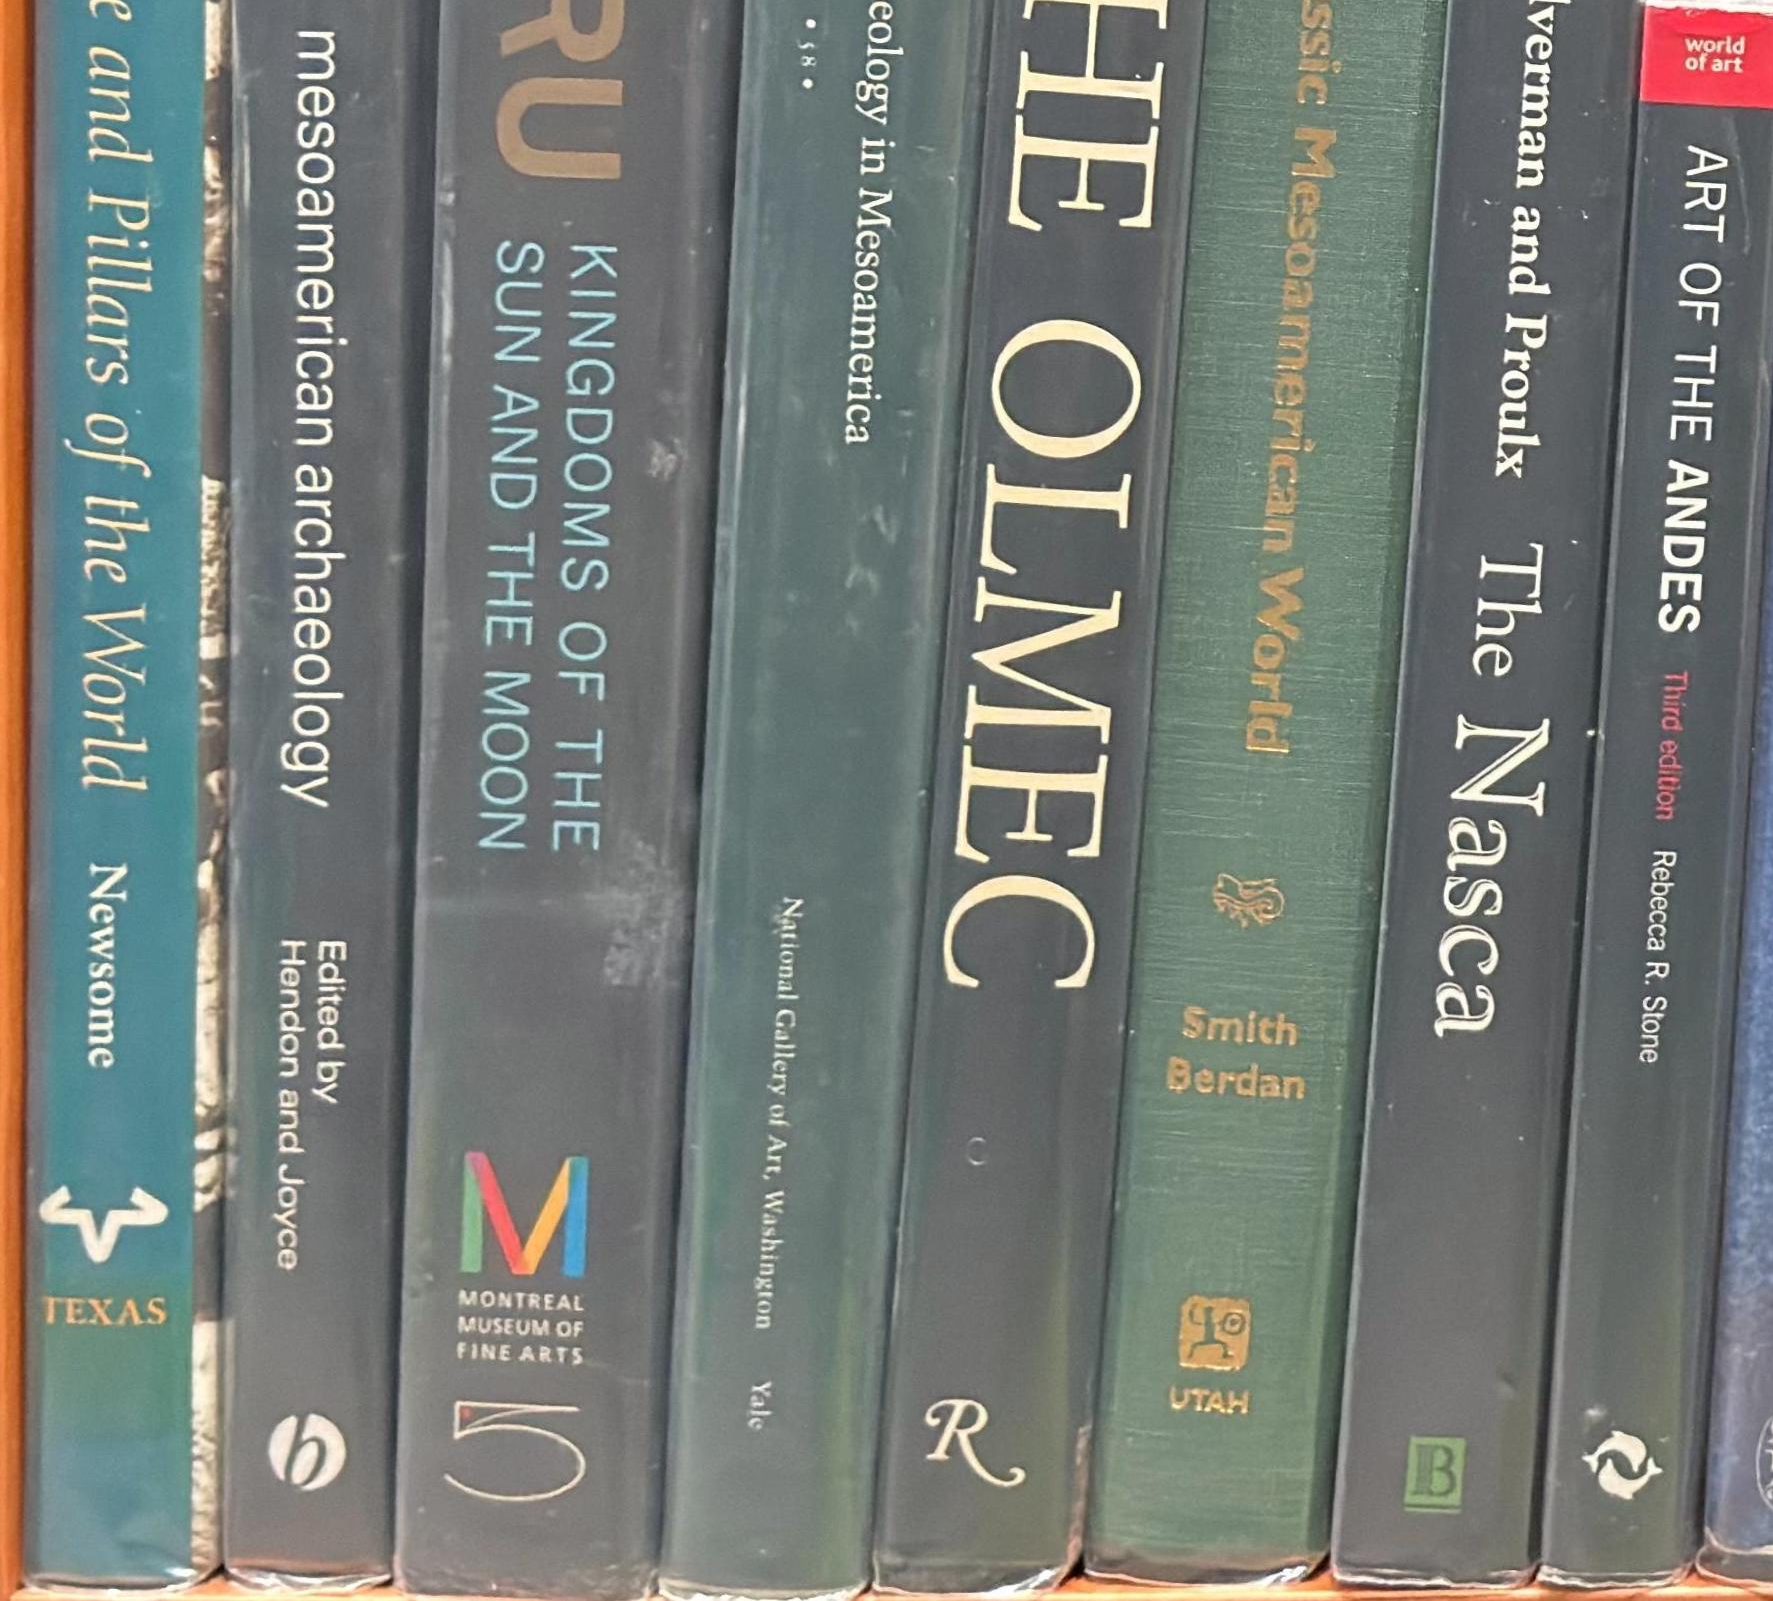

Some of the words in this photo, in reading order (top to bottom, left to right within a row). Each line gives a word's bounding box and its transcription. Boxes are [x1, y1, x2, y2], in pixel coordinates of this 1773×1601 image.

[1684, 54, 1706, 71] of
[1711, 57, 1743, 73] art
[1685, 35, 1746, 55] world
[88, 46, 154, 163] and
[858, 135, 897, 178] in
[1682, 144, 1729, 244] ART
[295, 30, 347, 446] mesoamerican
[1508, 206, 1552, 295] and
[85, 193, 153, 385] Pillars
[494, 240, 545, 362] SUN
[845, 187, 893, 444] Mesoamerica
[1258, 125, 1337, 553] Mesoamerican
[1678, 262, 1722, 327] OF
[560, 245, 618, 591] KINGDOMS
[1495, 312, 1548, 479] Proulx
[1669, 344, 1717, 442] THE
[64, 412, 152, 478] of
[490, 384, 540, 510] AND
[83, 495, 150, 583] the
[485, 531, 536, 646] THE
[1657, 459, 1709, 633] ANDES
[281, 465, 345, 809] archaeology
[943, 319, 1142, 988] OLMEC
[1472, 542, 1544, 677] The
[81, 606, 148, 791] World
[558, 621, 607, 701] OF
[1245, 567, 1305, 754] World
[1661, 671, 1689, 732] Third
[478, 671, 531, 849] MOON
[552, 728, 603, 851] THE
[1655, 739, 1683, 820] edition
[1433, 713, 1550, 1038] Nasca
[1646, 850, 1677, 951] Rebecca
[87, 863, 128, 1069] Newsome
[316, 940, 347, 1050] Edited
[777, 897, 804, 1000] National
[1645, 962, 1670, 987] R.
[279, 940, 307, 1078] Hendon
[766, 1008, 796, 1096] Gallery
[1181, 1005, 1298, 1046] Smith
[1639, 996, 1668, 1063] Stone
[278, 1088, 305, 1154] and
[311, 1061, 346, 1104] by
[769, 1104, 789, 1126] of
[1167, 1056, 1305, 1100] Berdan
[762, 1134, 788, 1180] Art,
[272, 1163, 305, 1270] Joyce
[754, 1190, 785, 1329] Washington
[43, 1296, 167, 1327] TEXAS
[457, 1315, 550, 1336] MUSEUM
[555, 1321, 584, 1338] OF
[458, 1289, 585, 1312] MONTREAL
[456, 1341, 511, 1362] FINE
[518, 1345, 583, 1365] ARTS
[1170, 1387, 1249, 1415] UTAH
[748, 1381, 772, 1430] Yale
